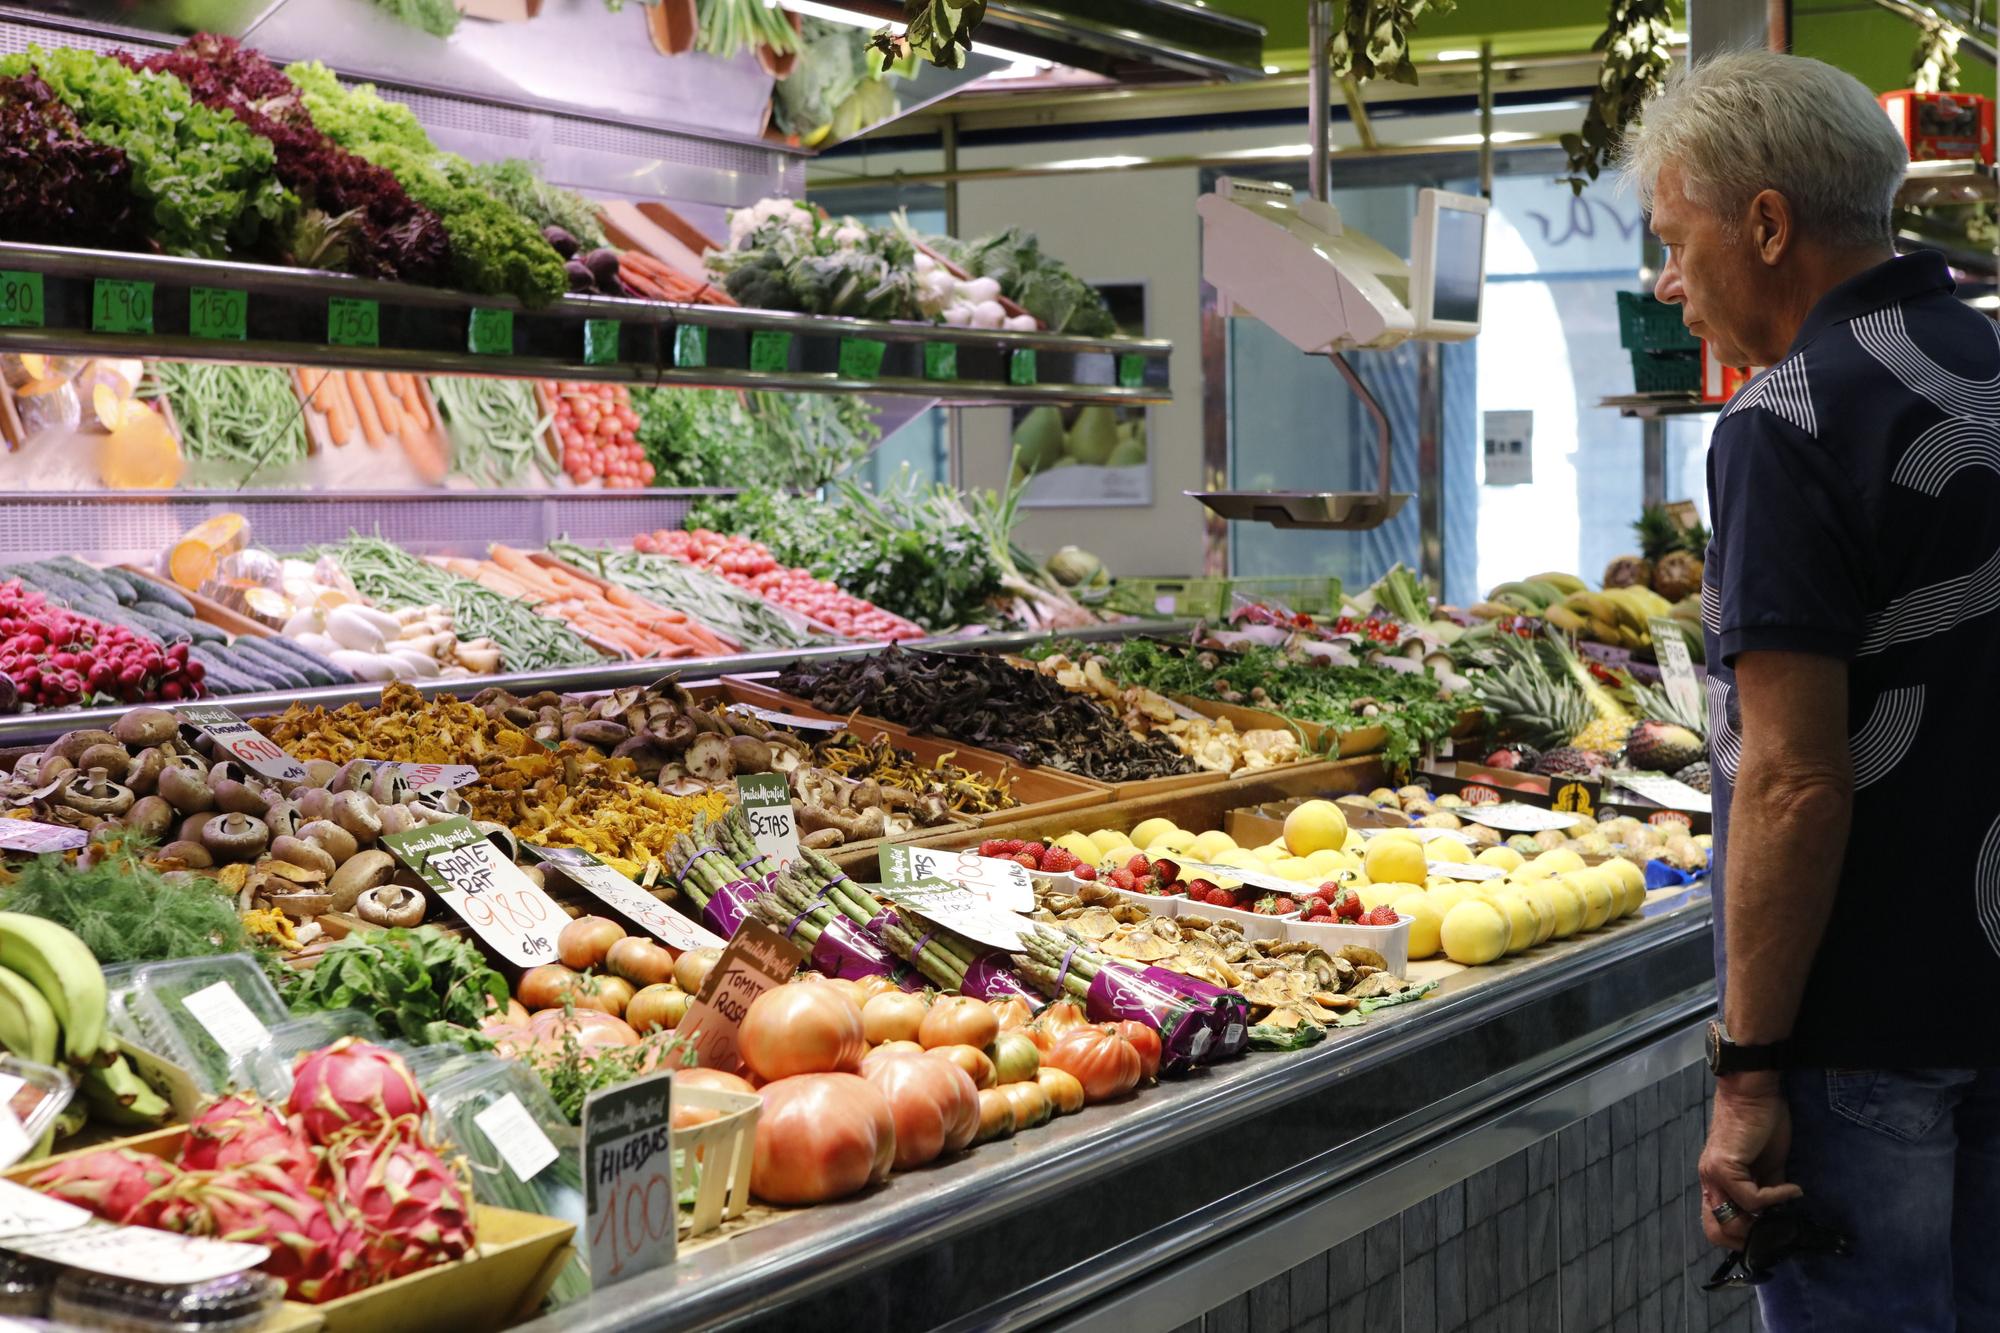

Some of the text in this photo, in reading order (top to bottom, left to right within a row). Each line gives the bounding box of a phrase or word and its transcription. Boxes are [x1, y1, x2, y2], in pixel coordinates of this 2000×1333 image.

[749, 811, 790, 838] SETAS
[420, 842, 490, 882] TOMATE
[723, 969, 767, 1001] TOMAT
[599, 1126, 669, 1185] HIERBAS
